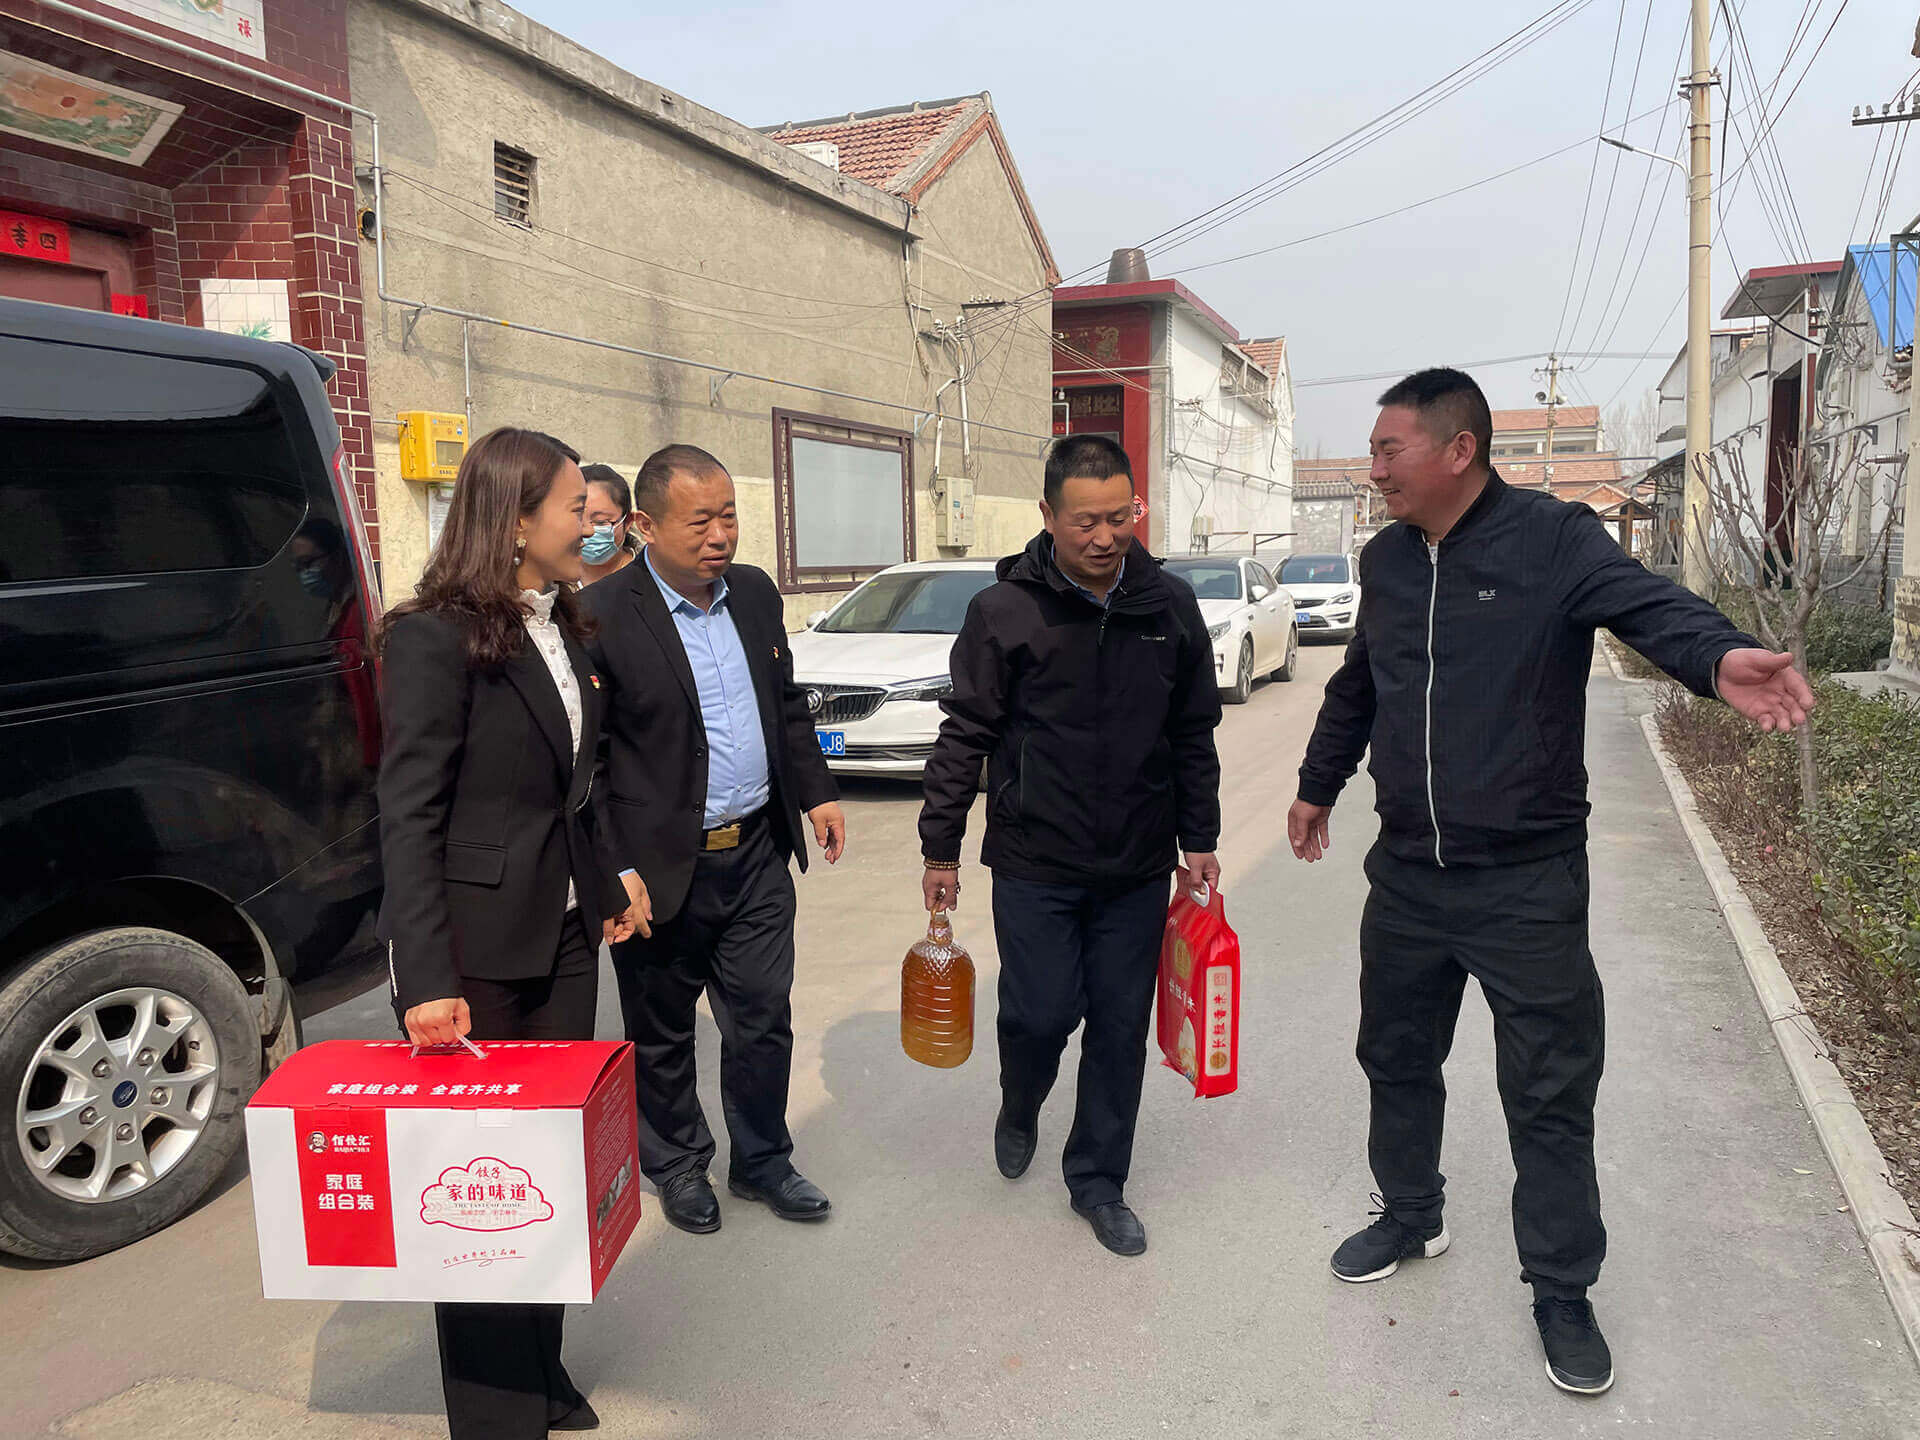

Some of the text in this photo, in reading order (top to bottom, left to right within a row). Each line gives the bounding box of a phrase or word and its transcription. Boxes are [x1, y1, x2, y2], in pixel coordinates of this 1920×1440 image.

[327, 1084, 522, 1095] 家庭组合装 全家齐共享
[326, 1173, 363, 1190] 家庭
[446, 1183, 527, 1201] 家的味道
[318, 1193, 374, 1210] 组合装
